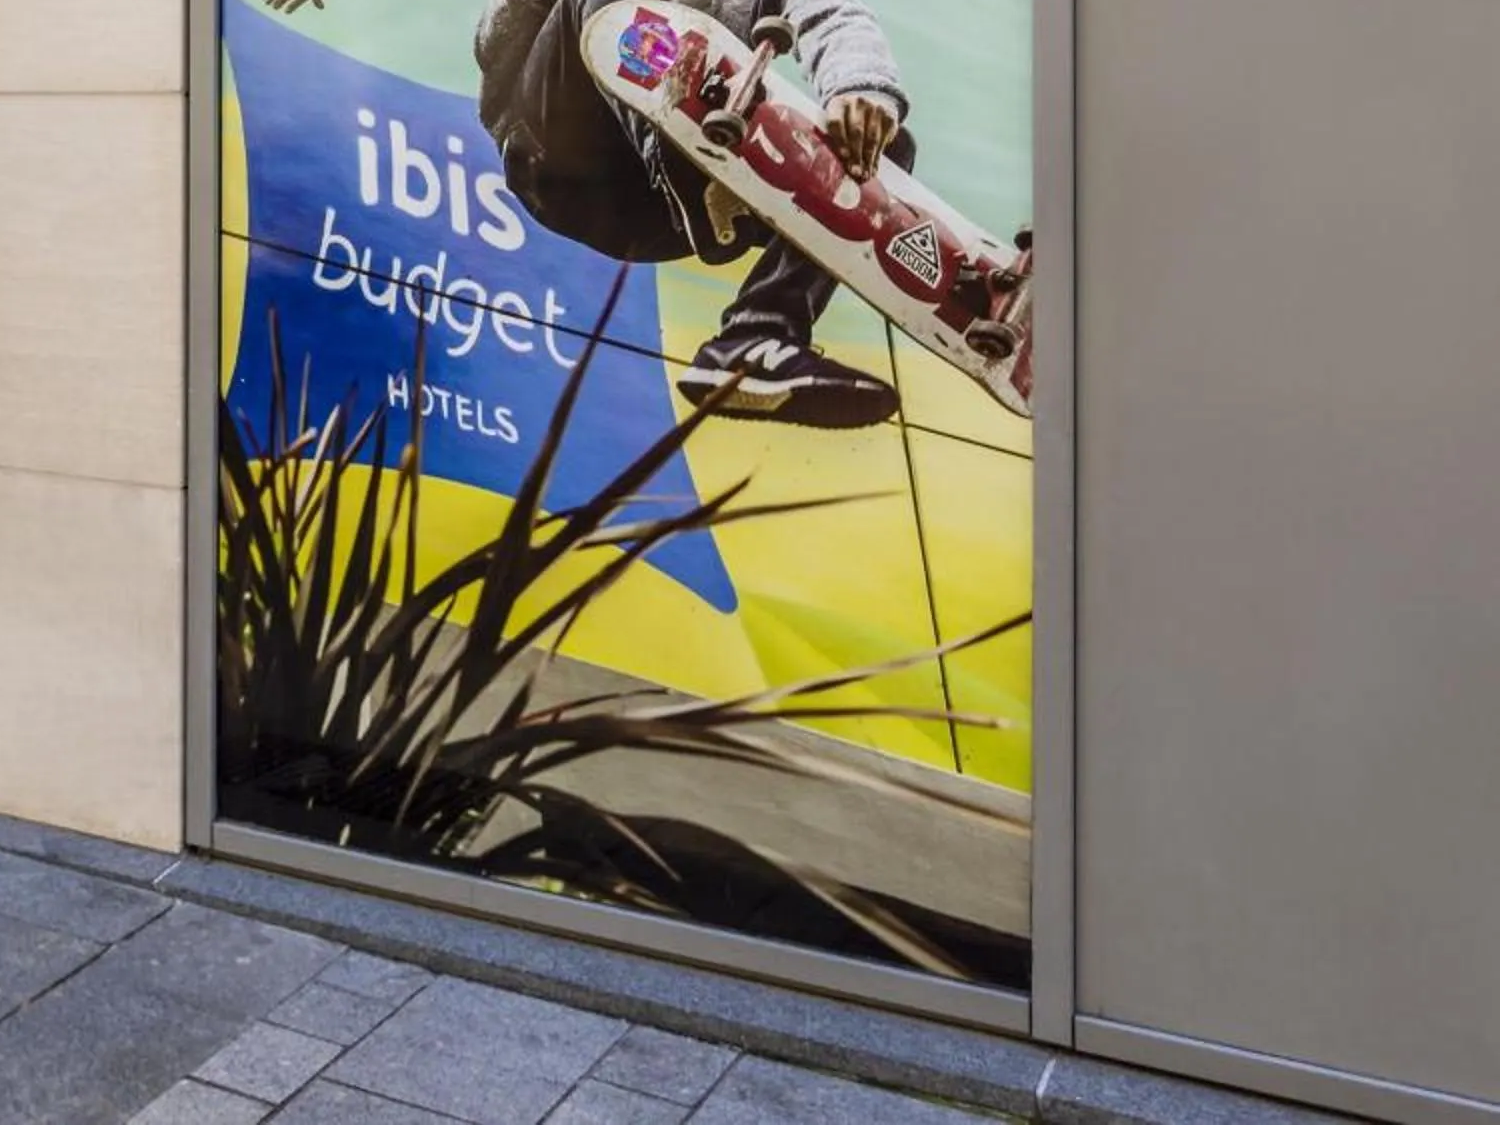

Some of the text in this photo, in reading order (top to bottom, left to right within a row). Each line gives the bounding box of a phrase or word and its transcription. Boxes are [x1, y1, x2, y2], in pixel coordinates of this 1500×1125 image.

[355, 108, 526, 252] ibis
[311, 206, 579, 371] budget
[891, 239, 938, 285] WISDOM
